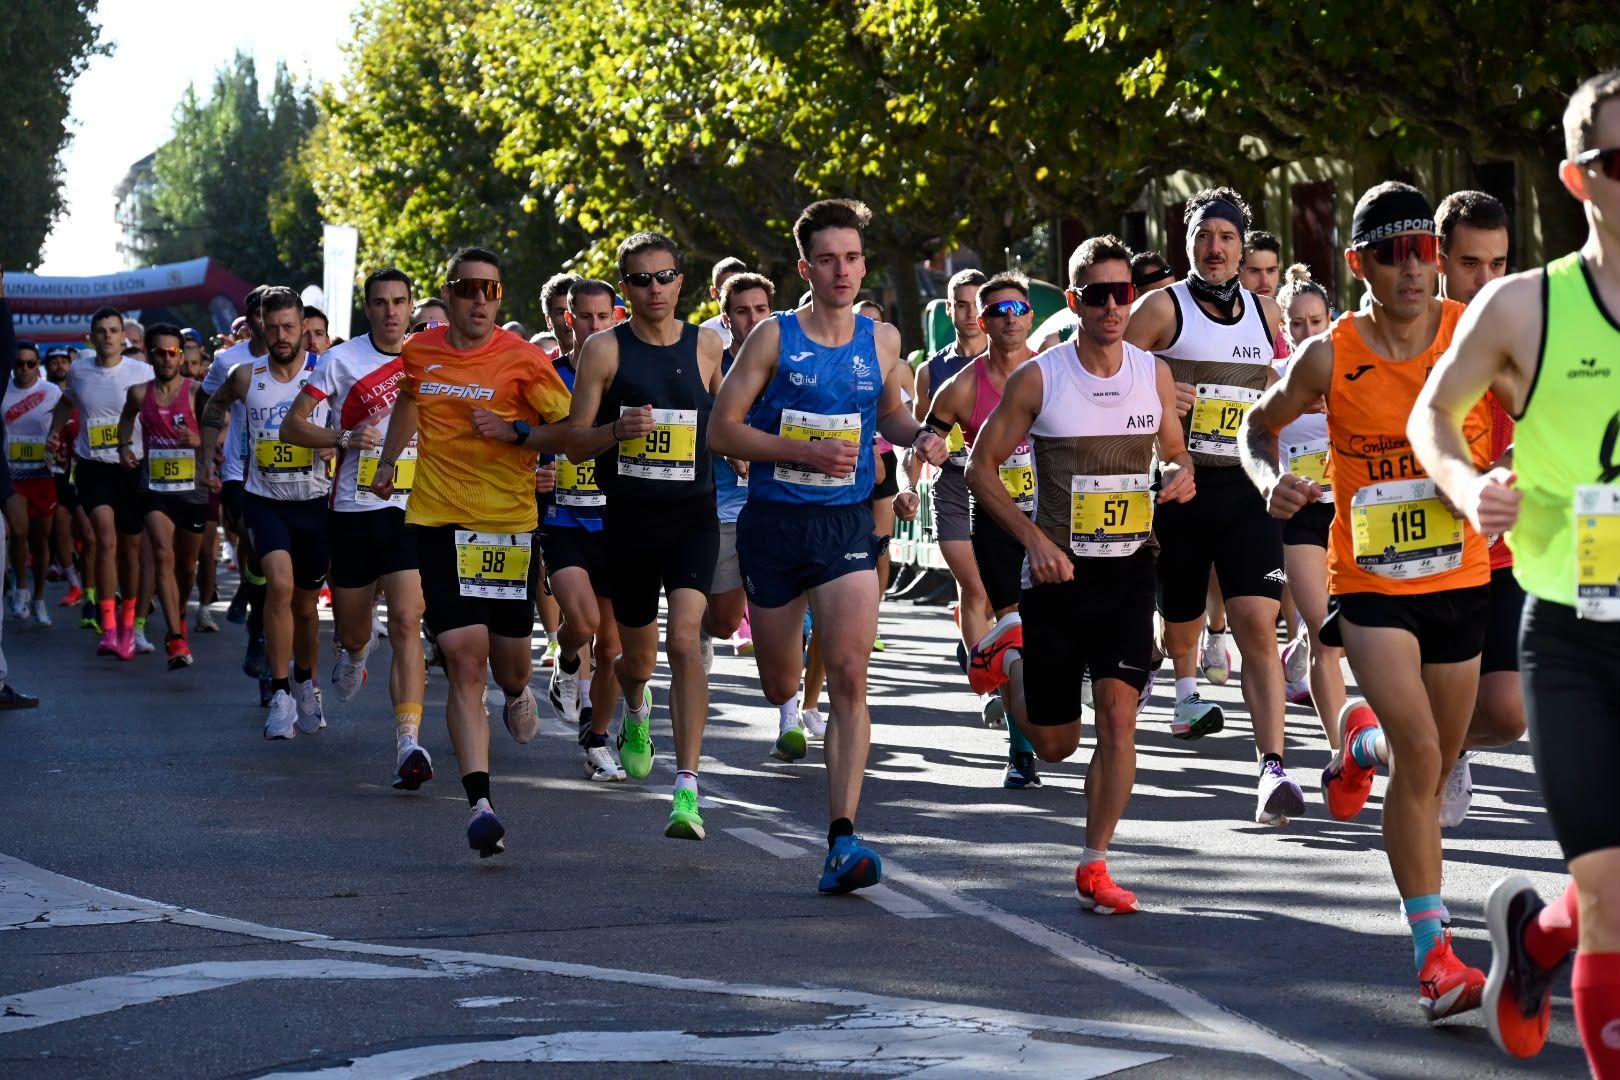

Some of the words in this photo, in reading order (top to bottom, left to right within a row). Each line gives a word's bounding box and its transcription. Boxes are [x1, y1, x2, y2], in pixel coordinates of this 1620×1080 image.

[93, 281, 108, 293] DE
[112, 277, 146, 291] LEÓN
[1232, 346, 1261, 359] ANR
[360, 393, 374, 404] LA
[418, 383, 496, 401] ESPAÑA
[367, 402, 382, 417] DE
[1220, 406, 1244, 430] 121
[1126, 414, 1154, 429] ANR
[101, 427, 119, 442] 164
[645, 430, 671, 453] 99
[20, 445, 33, 458] 110
[273, 445, 293, 463] 35
[163, 461, 179, 476] 65
[576, 466, 596, 485] 52
[1366, 458, 1394, 481] LA
[1398, 453, 1427, 478] FL
[1022, 471, 1037, 491] 3
[1103, 499, 1129, 527] 57
[1391, 509, 1427, 543] 119
[481, 550, 506, 573] 98
